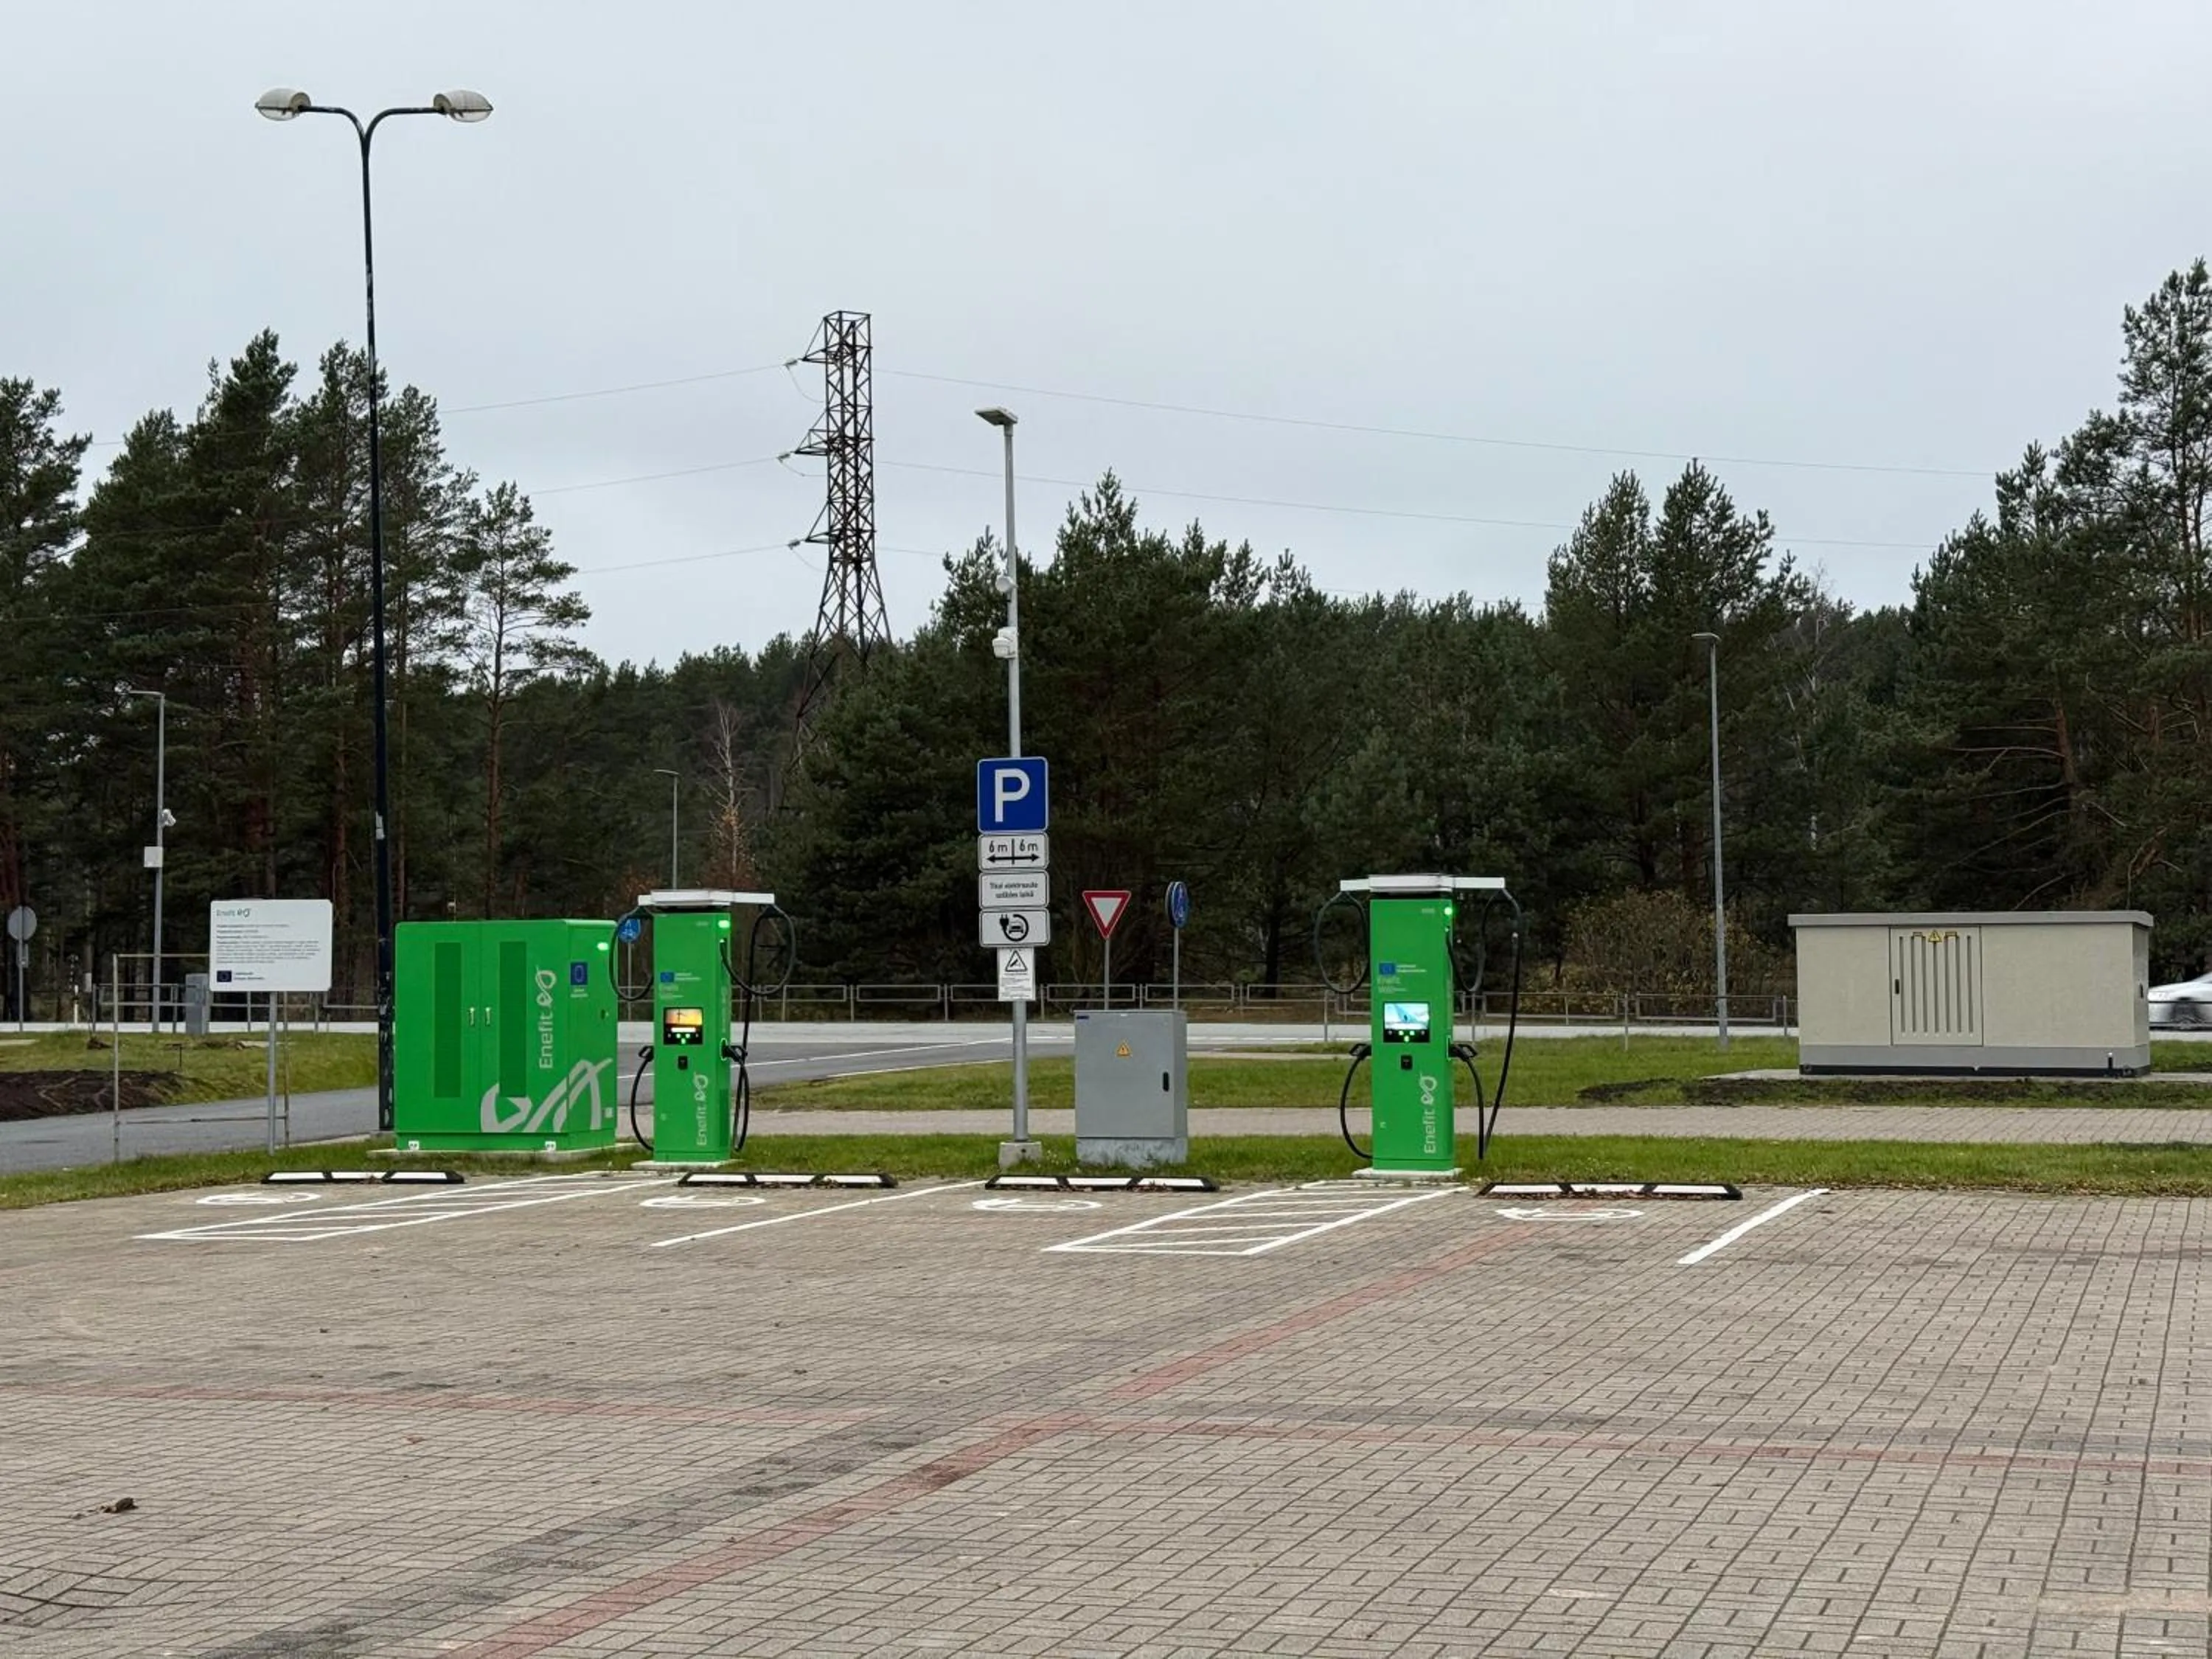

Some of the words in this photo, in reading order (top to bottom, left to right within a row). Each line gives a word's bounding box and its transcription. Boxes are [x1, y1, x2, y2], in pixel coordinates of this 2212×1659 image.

[994, 768, 1030, 823] P
[989, 840, 995, 853] 6
[998, 844, 1008, 852] m
[1020, 838, 1026, 852] 6
[1027, 843, 1038, 852] m
[538, 1011, 553, 1068] Enefit
[1422, 1109, 1436, 1154] Enefit
